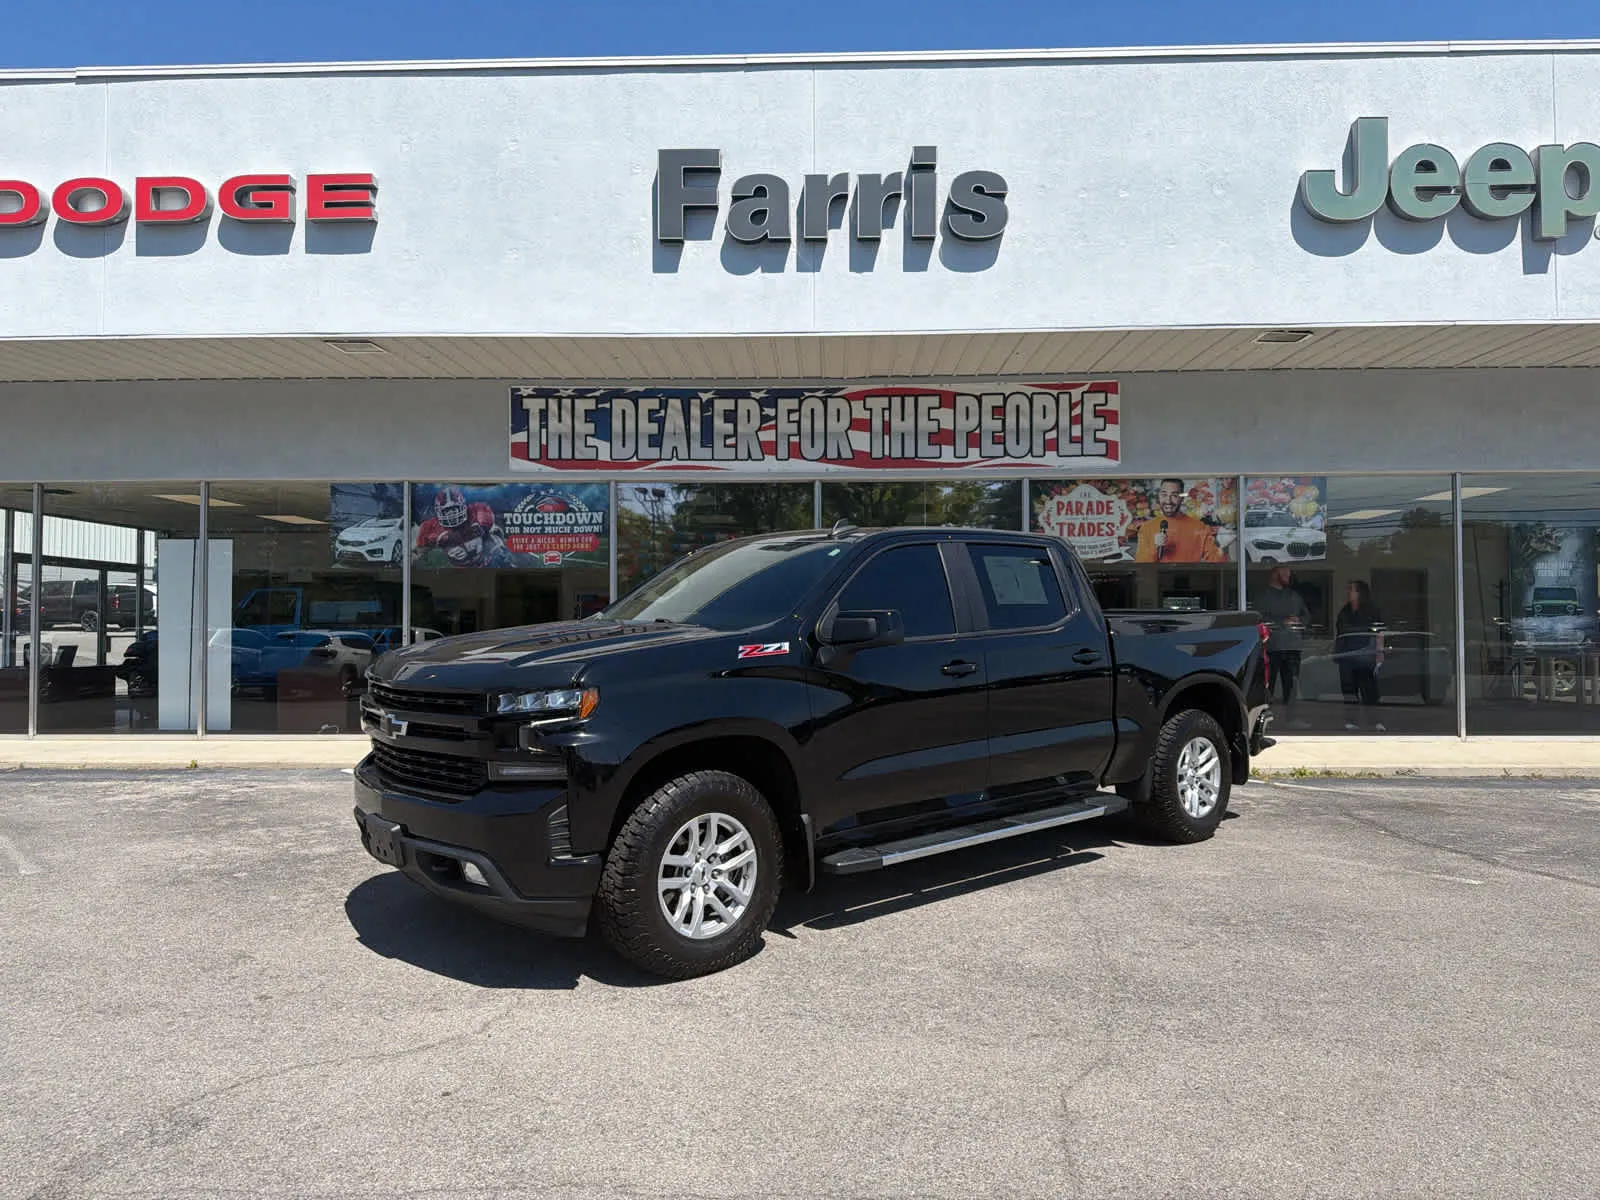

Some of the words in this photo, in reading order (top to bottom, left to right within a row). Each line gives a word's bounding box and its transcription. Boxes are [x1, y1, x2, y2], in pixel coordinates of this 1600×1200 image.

[1304, 117, 1600, 239] Jeep
[656, 146, 1009, 243] Farris
[521, 396, 599, 461] THE
[609, 396, 765, 461] DEALER
[775, 394, 855, 461] FOR
[863, 394, 942, 459] THE
[953, 390, 1108, 458] PEOPLE
[1056, 500, 1115, 516] PARADE
[503, 511, 604, 525] TOUCHDOWN
[505, 526, 520, 534] FOR
[523, 526, 542, 534] NOT
[544, 526, 571, 534] MUCH
[573, 525, 603, 533] DOWN!
[1056, 521, 1116, 537] TRADES
